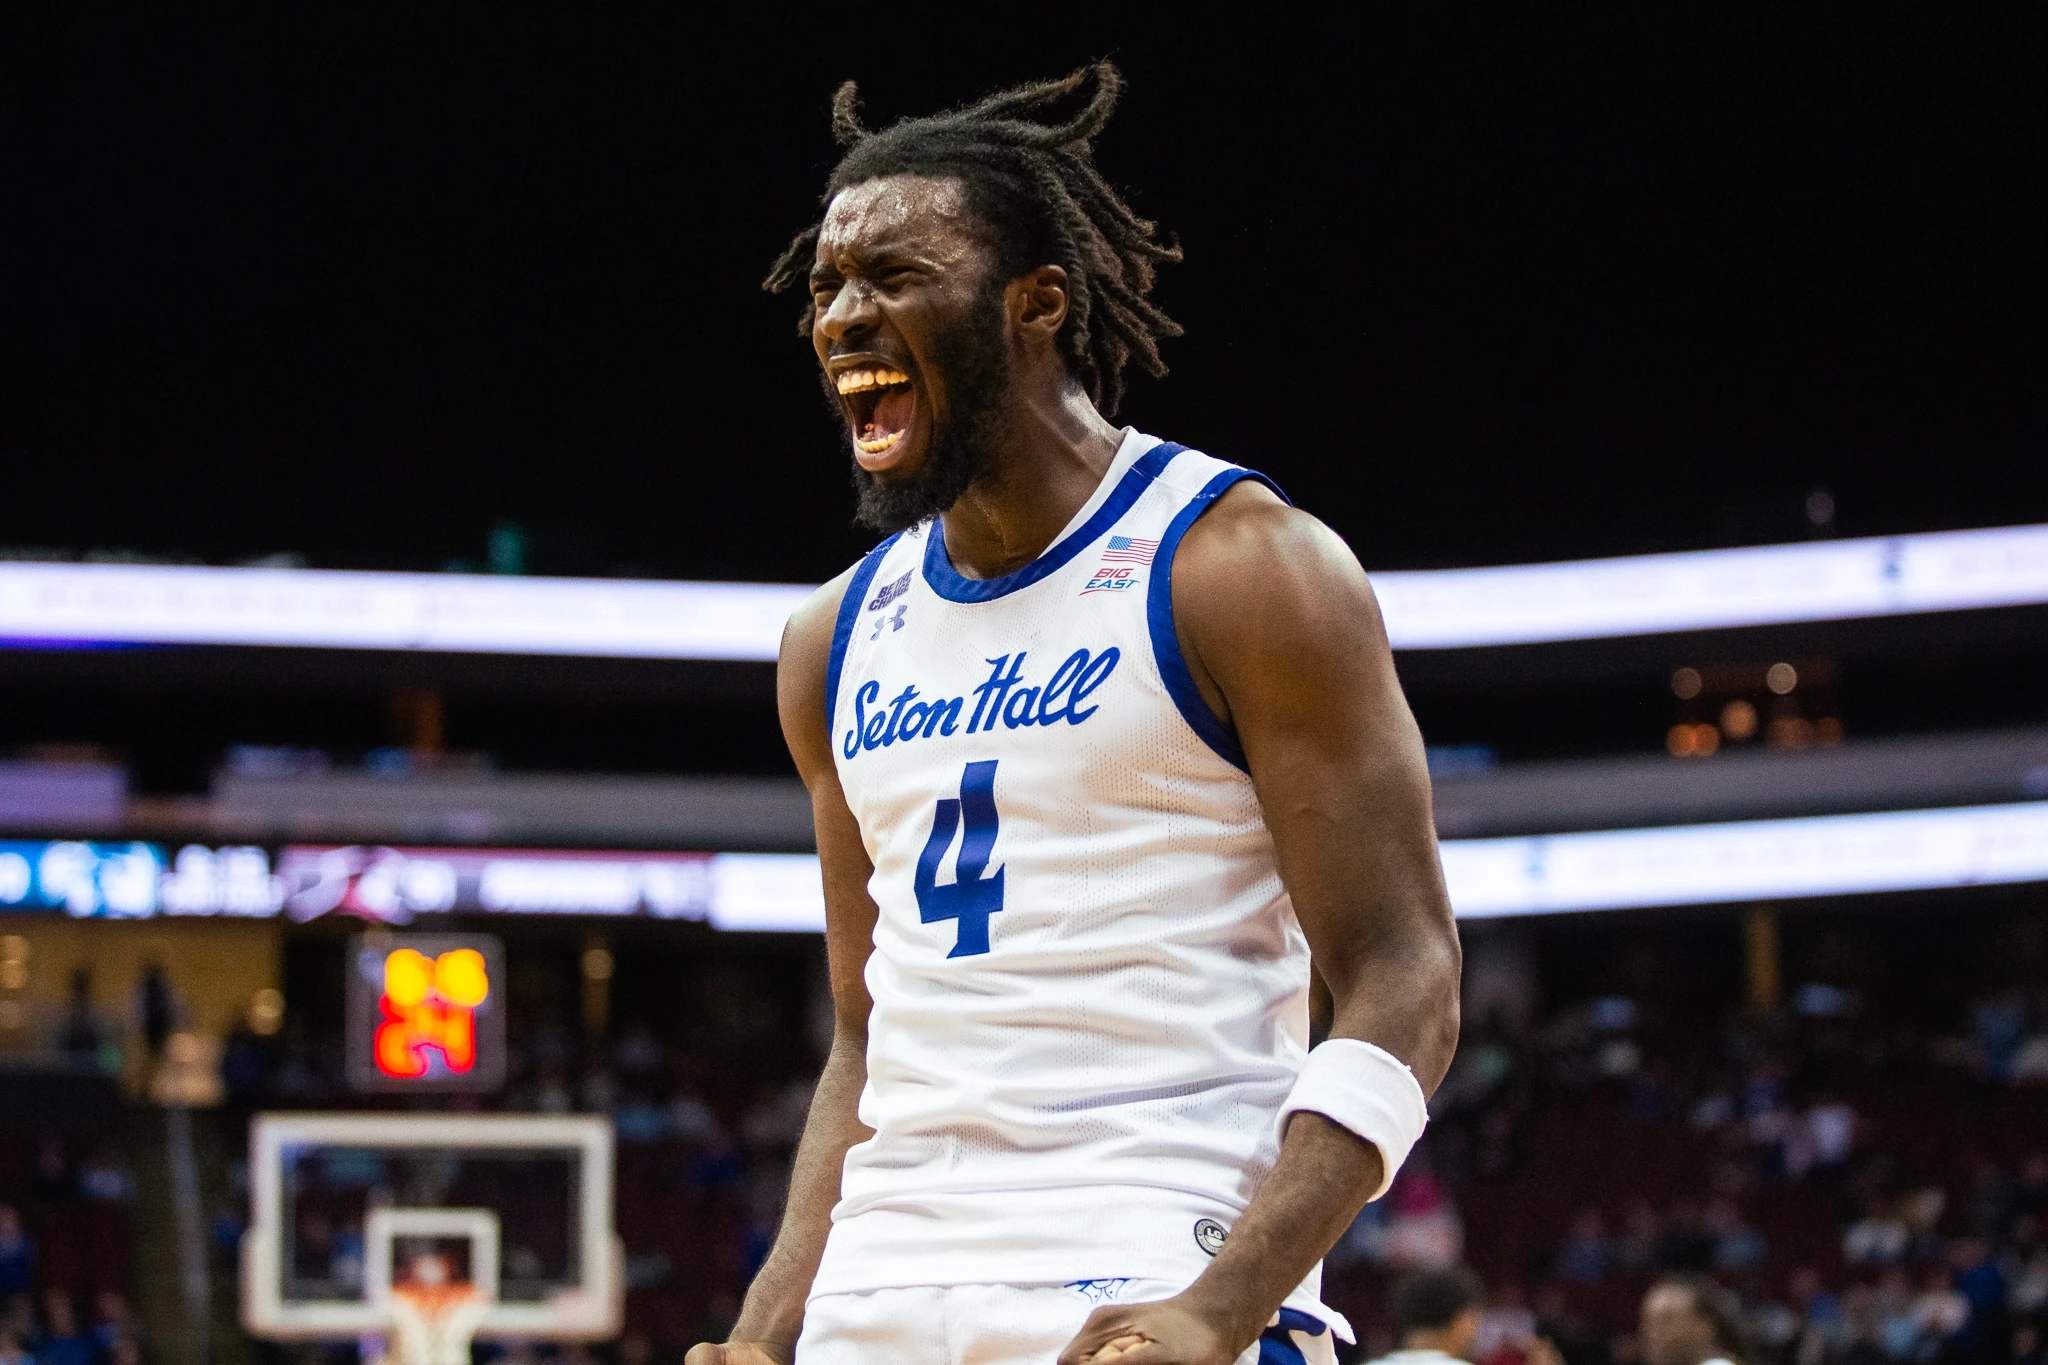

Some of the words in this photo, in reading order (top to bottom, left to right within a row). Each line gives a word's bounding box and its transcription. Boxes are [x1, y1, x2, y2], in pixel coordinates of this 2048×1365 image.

[878, 582, 895, 598] BE
[895, 567, 915, 589] THE
[1085, 579, 1140, 590] EAST
[1094, 568, 1134, 578] BIG
[869, 578, 911, 611] CHANGE
[844, 680, 964, 760] Seton
[966, 647, 1120, 734] Hall
[915, 759, 1005, 959] 4
